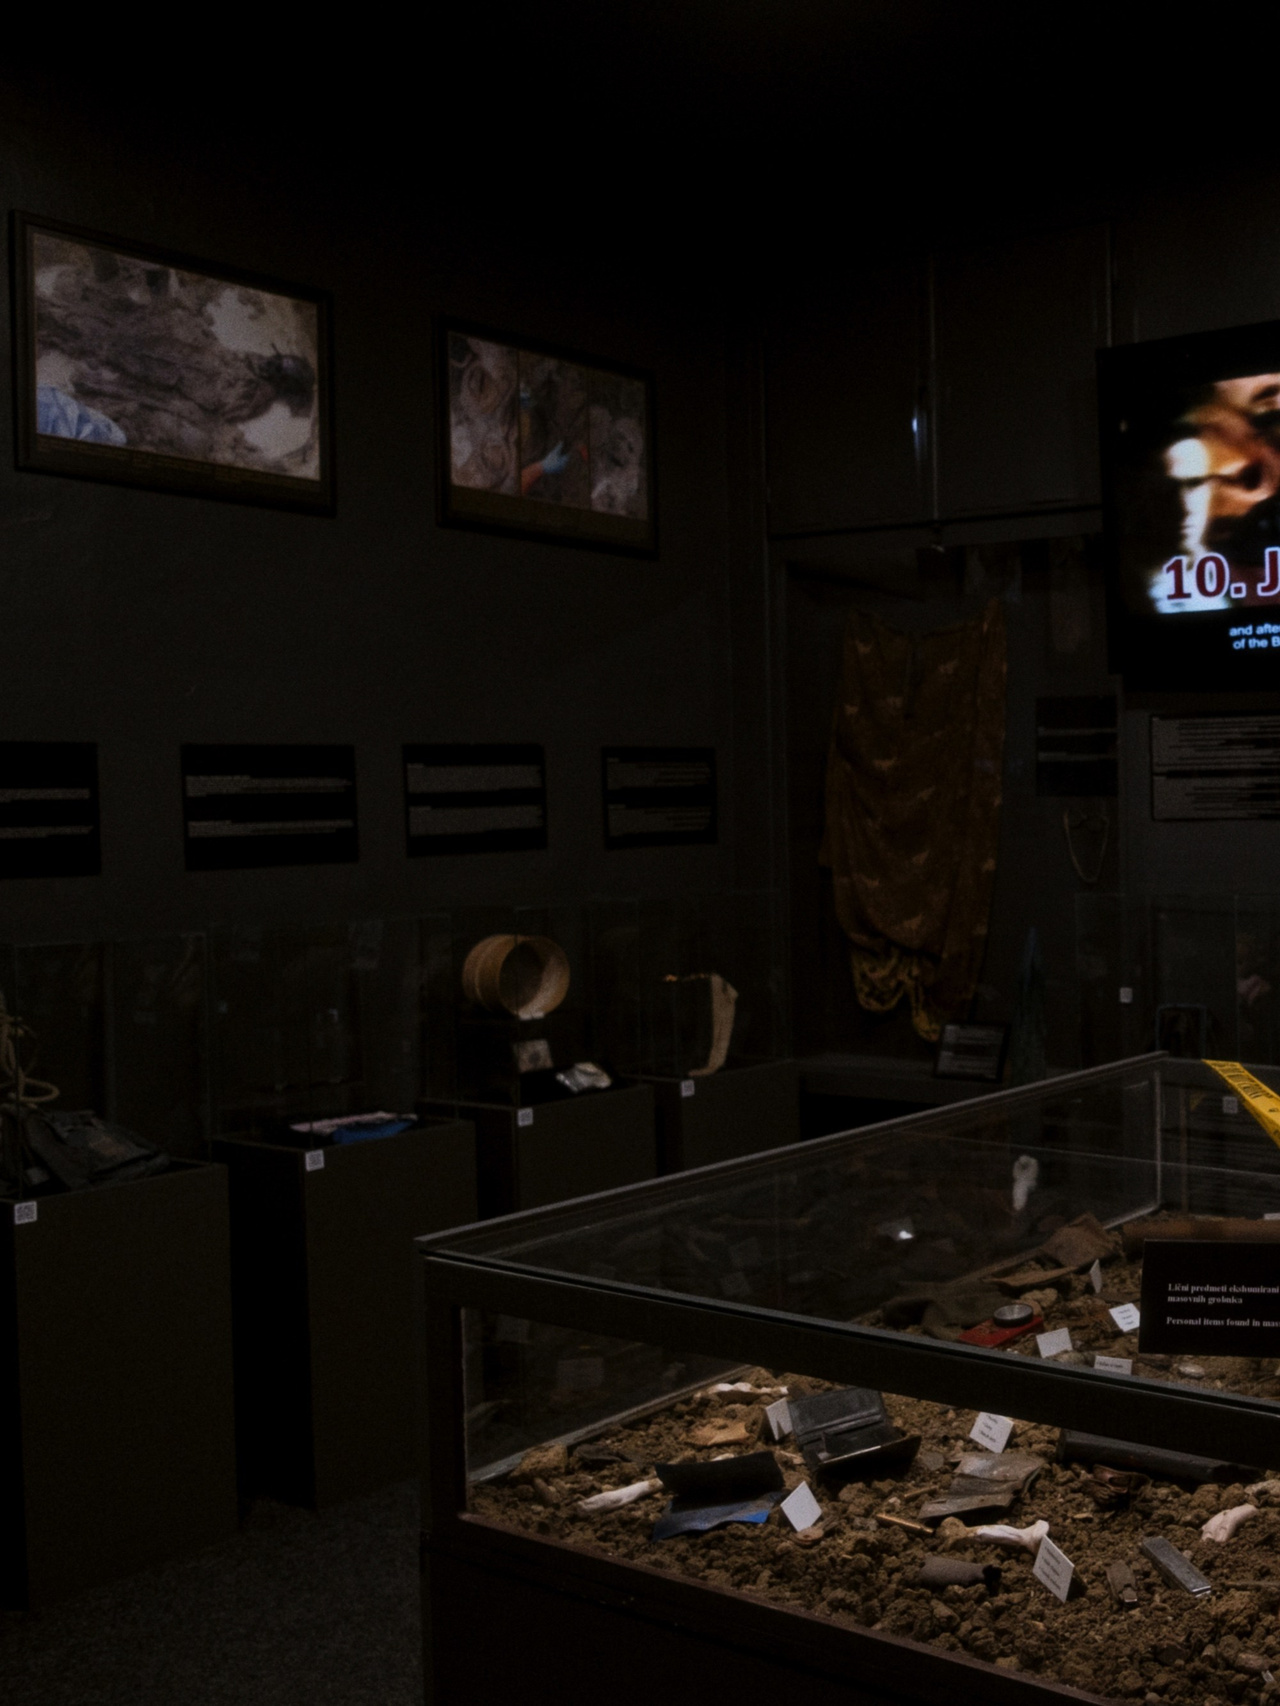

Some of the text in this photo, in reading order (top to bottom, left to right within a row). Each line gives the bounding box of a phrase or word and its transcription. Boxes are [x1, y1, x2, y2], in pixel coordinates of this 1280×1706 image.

[1163, 552, 1246, 600] 10.
[1229, 625, 1253, 637] and
[1233, 638, 1246, 650] of
[1248, 636, 1268, 648] the
[1166, 1316, 1201, 1325] Personal
[1203, 1317, 1225, 1326] items
[1226, 1318, 1250, 1327] found
[1252, 1319, 1260, 1327] in
